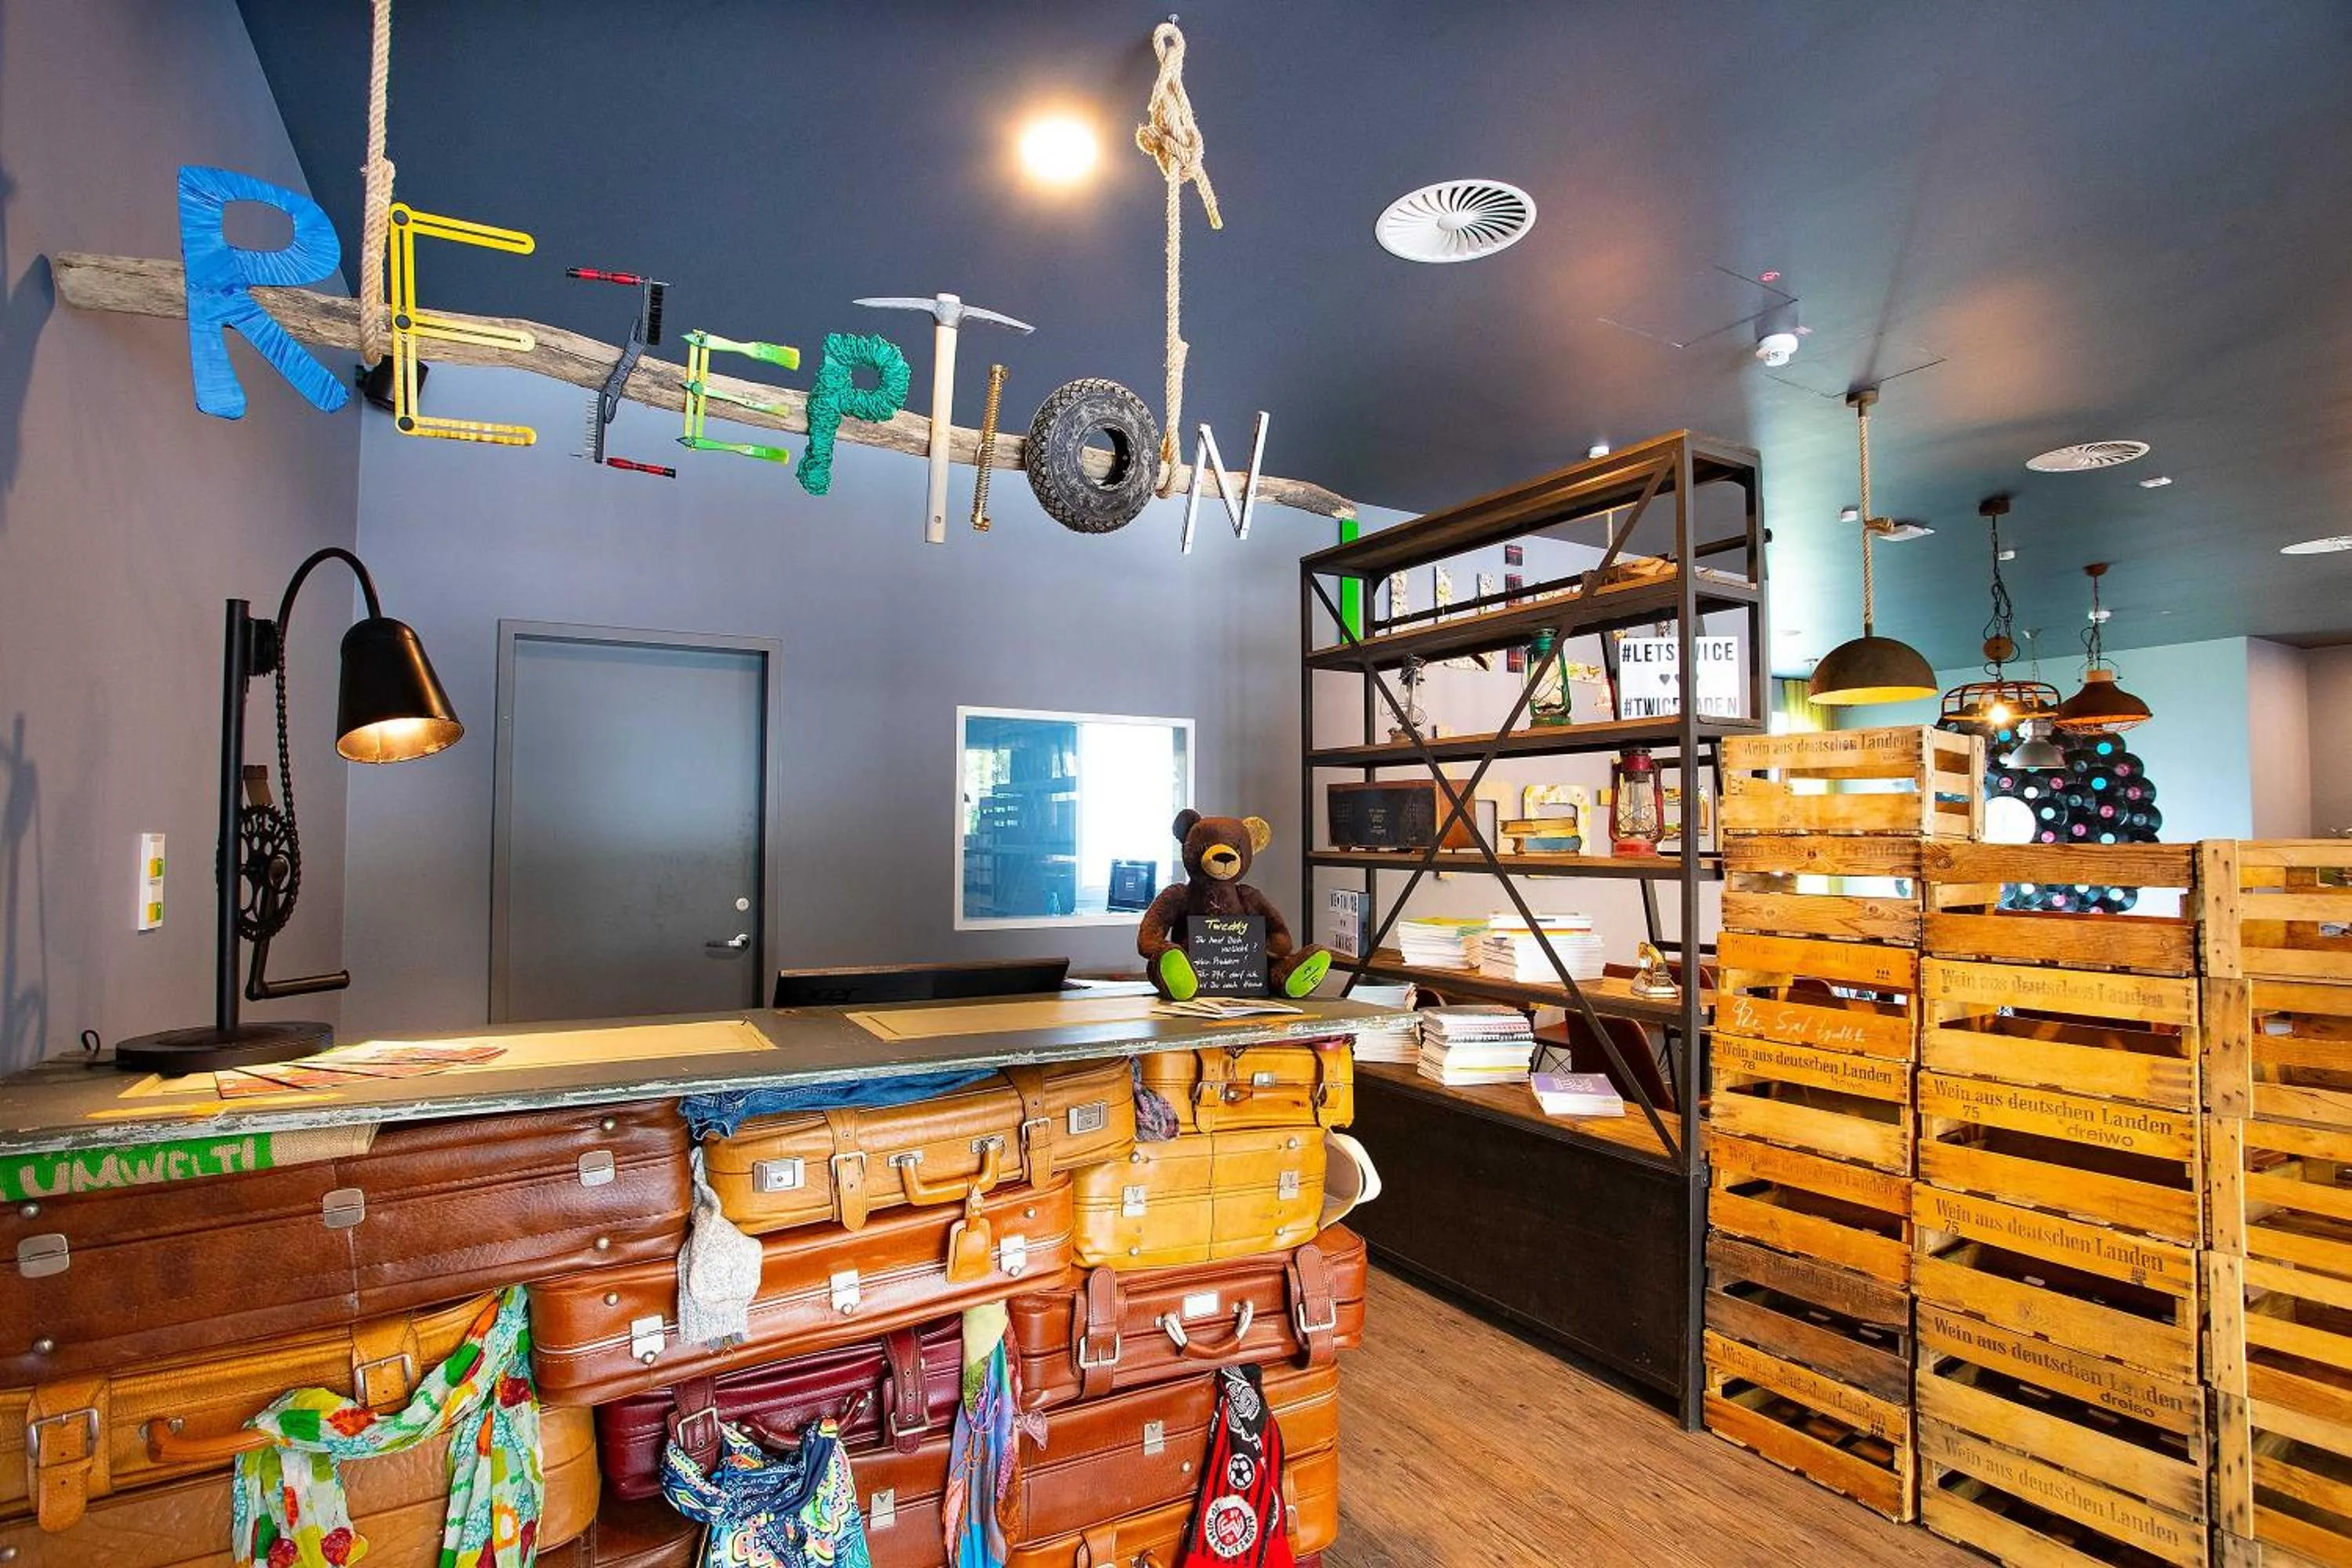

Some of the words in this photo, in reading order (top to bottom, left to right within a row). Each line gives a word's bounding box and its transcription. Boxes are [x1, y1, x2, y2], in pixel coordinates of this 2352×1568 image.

[1621, 642, 1734, 662] #LETSICE
[1722, 1040, 1749, 1058] Wein
[1752, 1045, 1774, 1060] aus
[1776, 1050, 1840, 1076] deutschen
[1842, 1062, 1893, 1085] Landen
[1934, 1079, 1971, 1102] Wein
[1973, 1087, 2005, 1107] aus
[2008, 1092, 2095, 1123] deutschen
[2101, 1107, 2172, 1137] Landen
[1962, 1104, 1980, 1120] 75
[1936, 1198, 1971, 1225] Wein
[1974, 1212, 2004, 1232] aus
[2008, 1217, 2092, 1254] deutschen
[2095, 1236, 2166, 1273] Landen
[1944, 1219, 1960, 1235] 75
[1933, 1316, 1973, 1345] Wein
[1976, 1334, 2008, 1355] aus
[2011, 1342, 2103, 1388] deutschen
[2109, 1373, 2184, 1413] Landen
[1944, 1435, 1982, 1467] Wein
[1986, 1454, 2015, 1481] aus
[2019, 1468, 2104, 1515] deutschen
[2109, 1499, 2180, 1548] Landen
